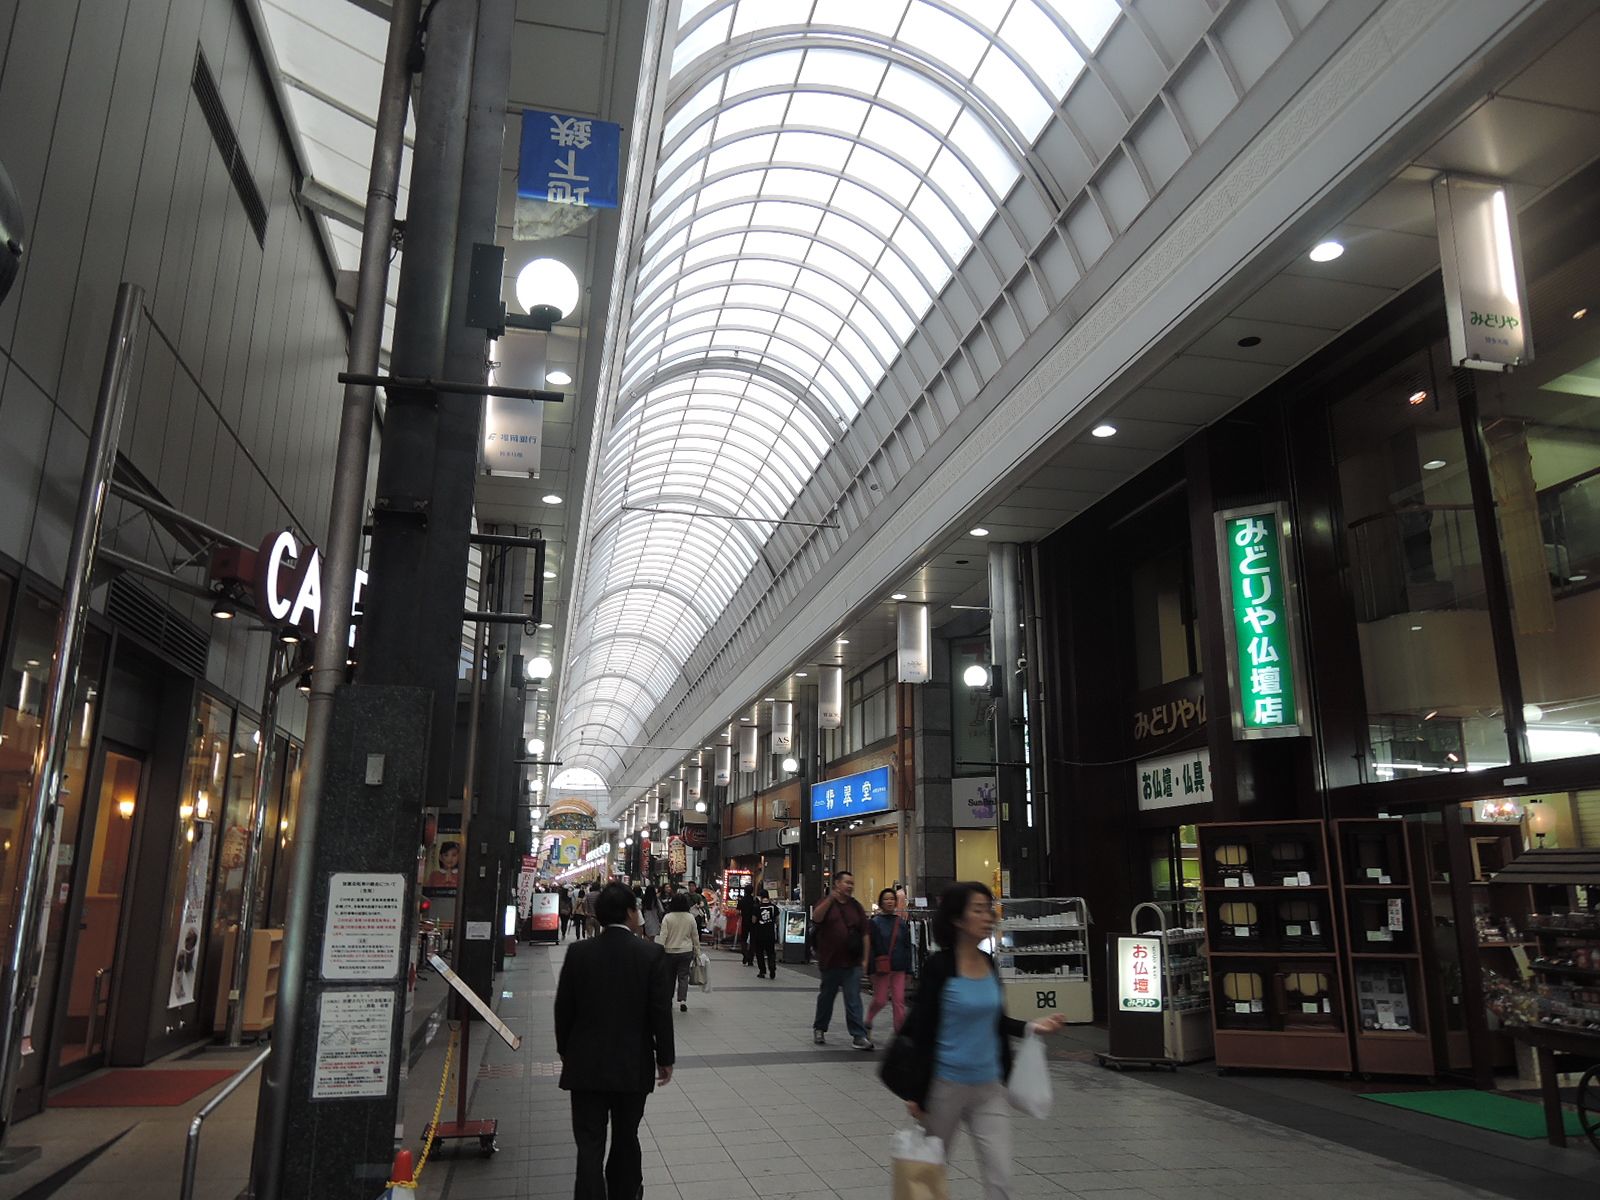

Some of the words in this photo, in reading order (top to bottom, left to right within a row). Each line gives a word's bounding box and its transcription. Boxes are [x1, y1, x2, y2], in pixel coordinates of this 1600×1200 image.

[547, 115, 593, 207] 地下鉄
[1471, 311, 1519, 330] みどりや
[1235, 518, 1283, 724] みどりや仏壇店
[1133, 944, 1149, 993] お仏壇
[1126, 998, 1156, 1008] みどりや
